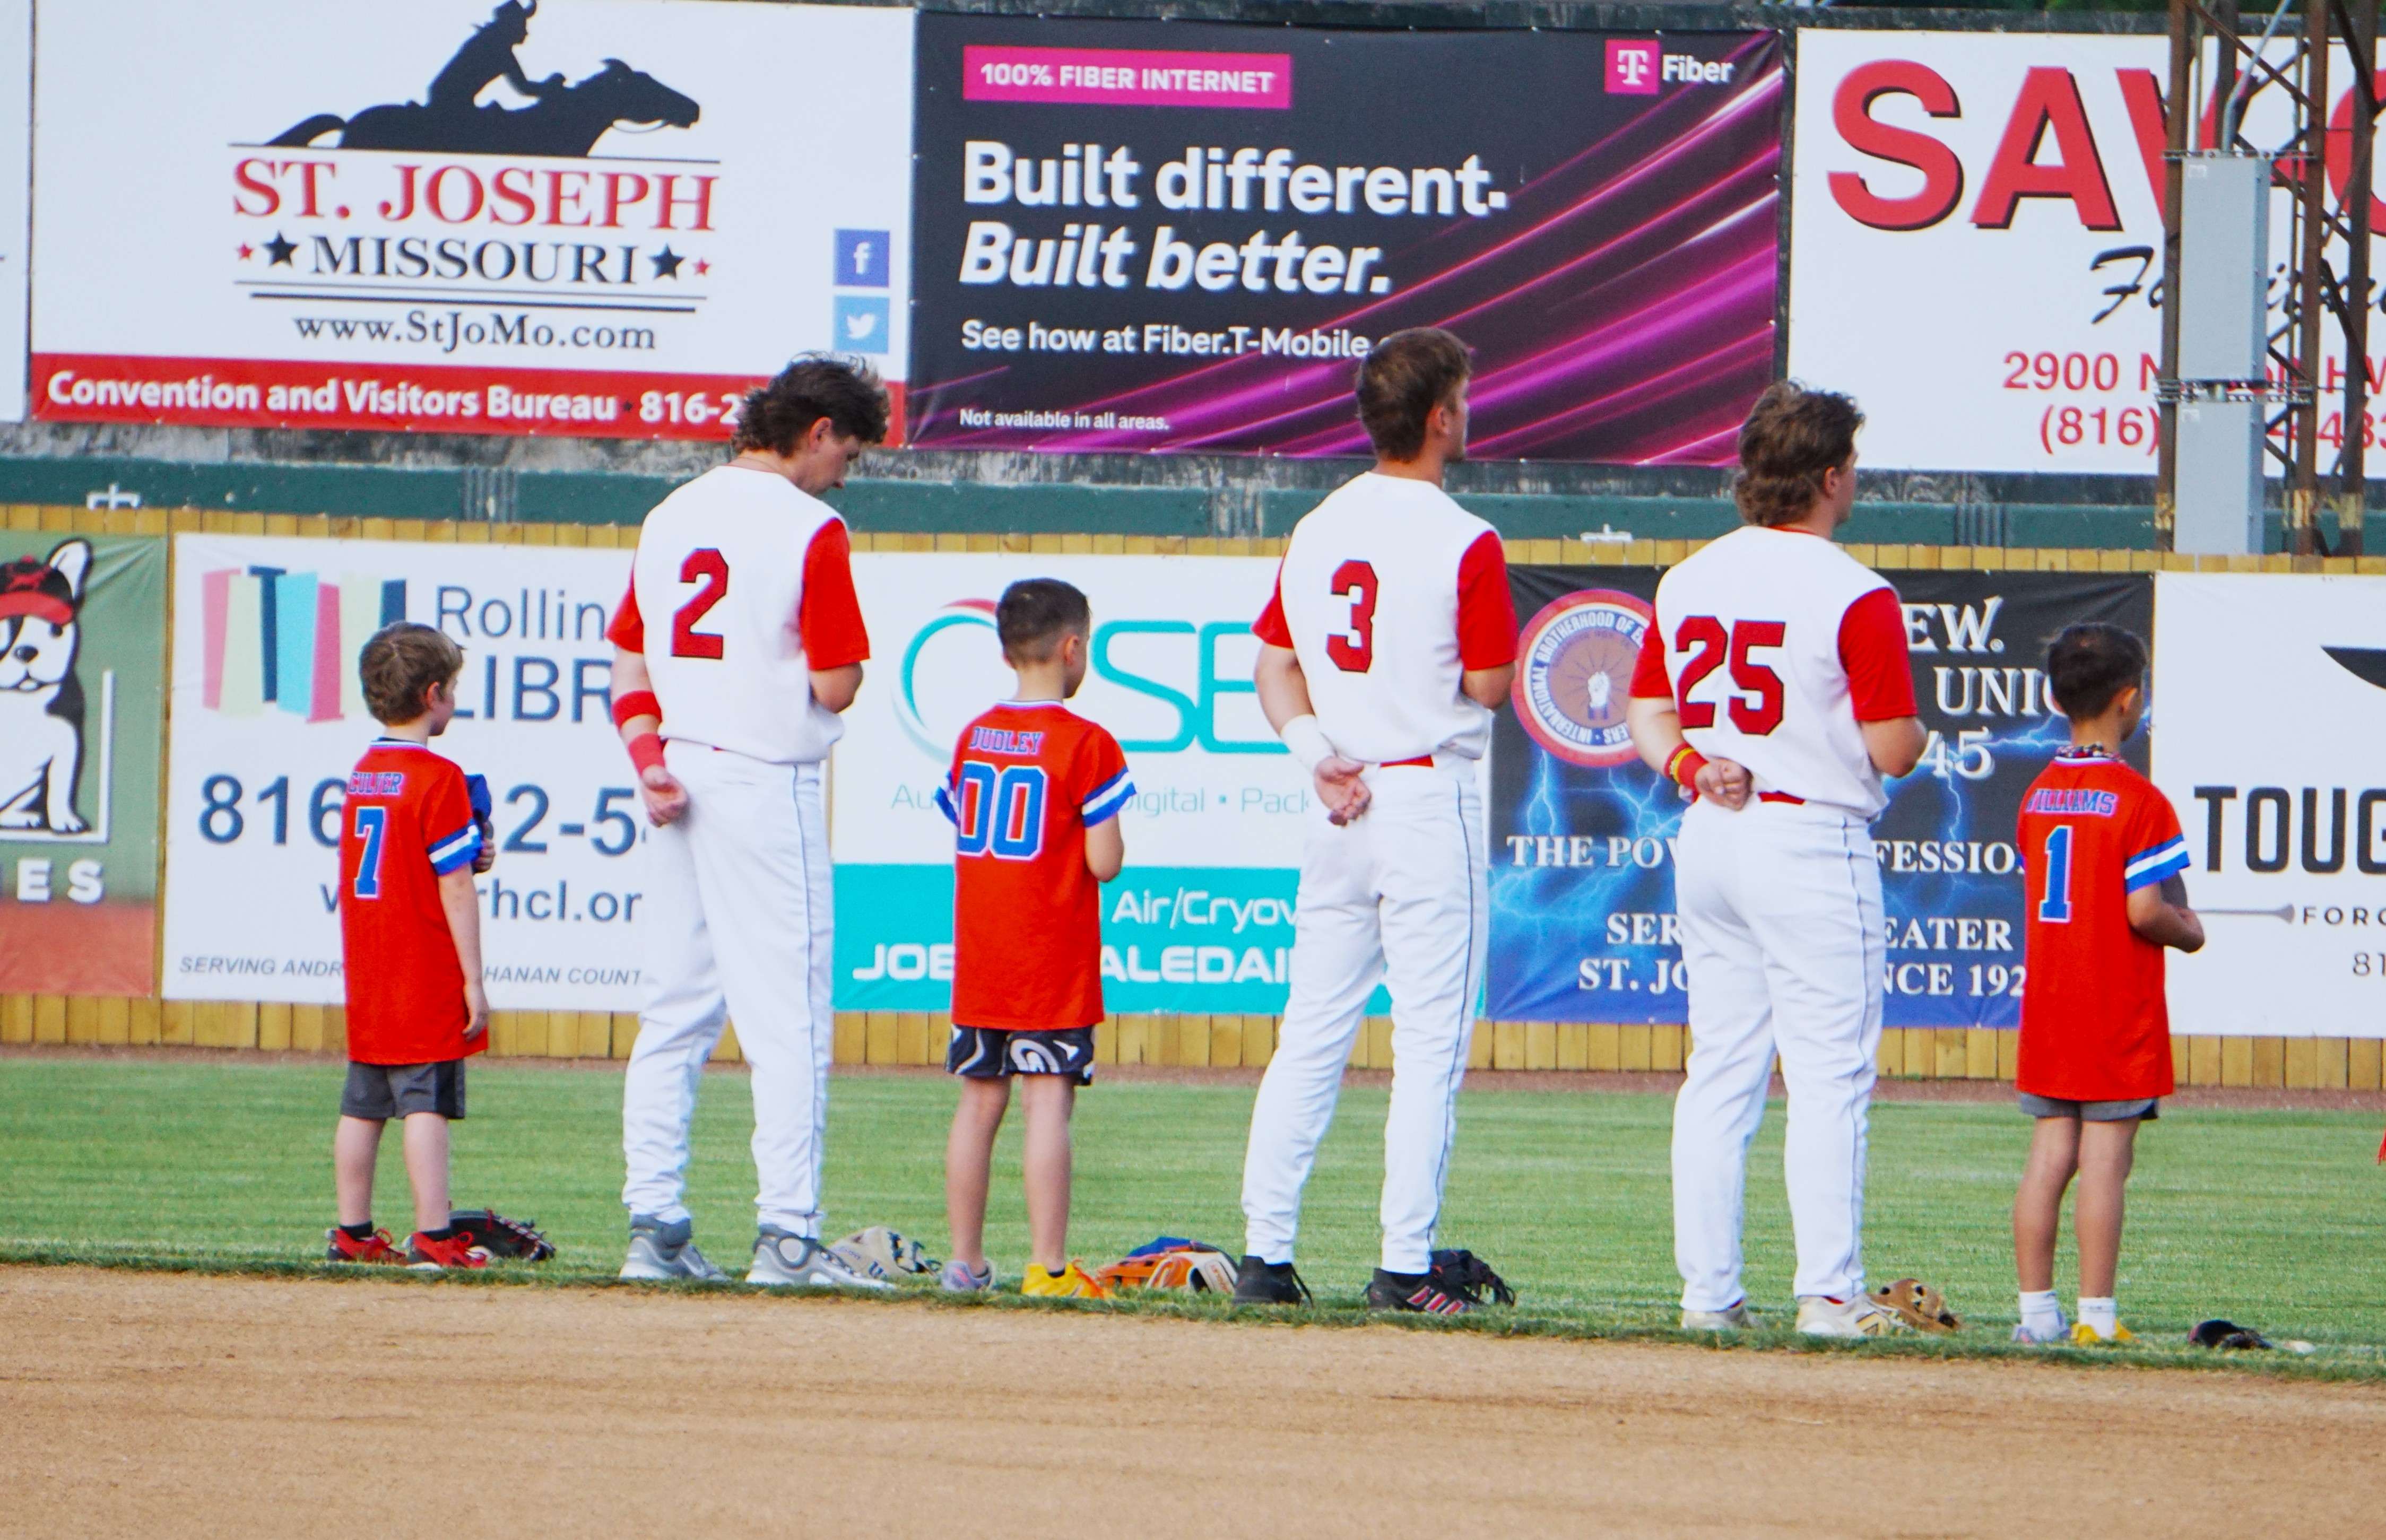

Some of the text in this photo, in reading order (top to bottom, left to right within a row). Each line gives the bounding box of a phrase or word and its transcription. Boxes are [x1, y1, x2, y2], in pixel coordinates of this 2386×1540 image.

[981, 63, 1275, 93] 100% FIBER INTERNET
[1662, 55, 1734, 83] Fiber
[233, 158, 720, 231] ST. JOSEPH
[963, 140, 1507, 217] Built different.
[310, 236, 638, 284] MISSOURI
[959, 221, 1391, 294] Built better.
[293, 311, 656, 352] www.StJoMo.com
[961, 319, 1019, 350] See
[1028, 321, 1097, 352] how
[1103, 326, 1137, 353] at
[48, 371, 258, 409] Convention
[266, 379, 338, 412] and
[343, 380, 481, 416] Visitors
[487, 386, 617, 421] Bureau
[2003, 352, 2119, 390] 2900
[959, 408, 1170, 430] Not available in all areas.
[435, 585, 605, 641] Rollin
[671, 547, 729, 660] 2
[1326, 559, 1378, 673] 3
[1535, 612, 1615, 663] BROTHERHOOD
[1616, 616, 1636, 637] OF
[453, 654, 614, 723] IBR
[1676, 615, 1785, 735] 25
[1933, 666, 2069, 716] UNI
[501, 784, 646, 857] 2-5
[956, 760, 1049, 860] 00
[354, 805, 386, 898] 7
[1506, 836, 1593, 867] THE
[1872, 840, 2025, 874] FESSIO
[2038, 825, 2073, 923] 1
[179, 956, 275, 976] SERVING
[1578, 958, 1639, 991] ST.
